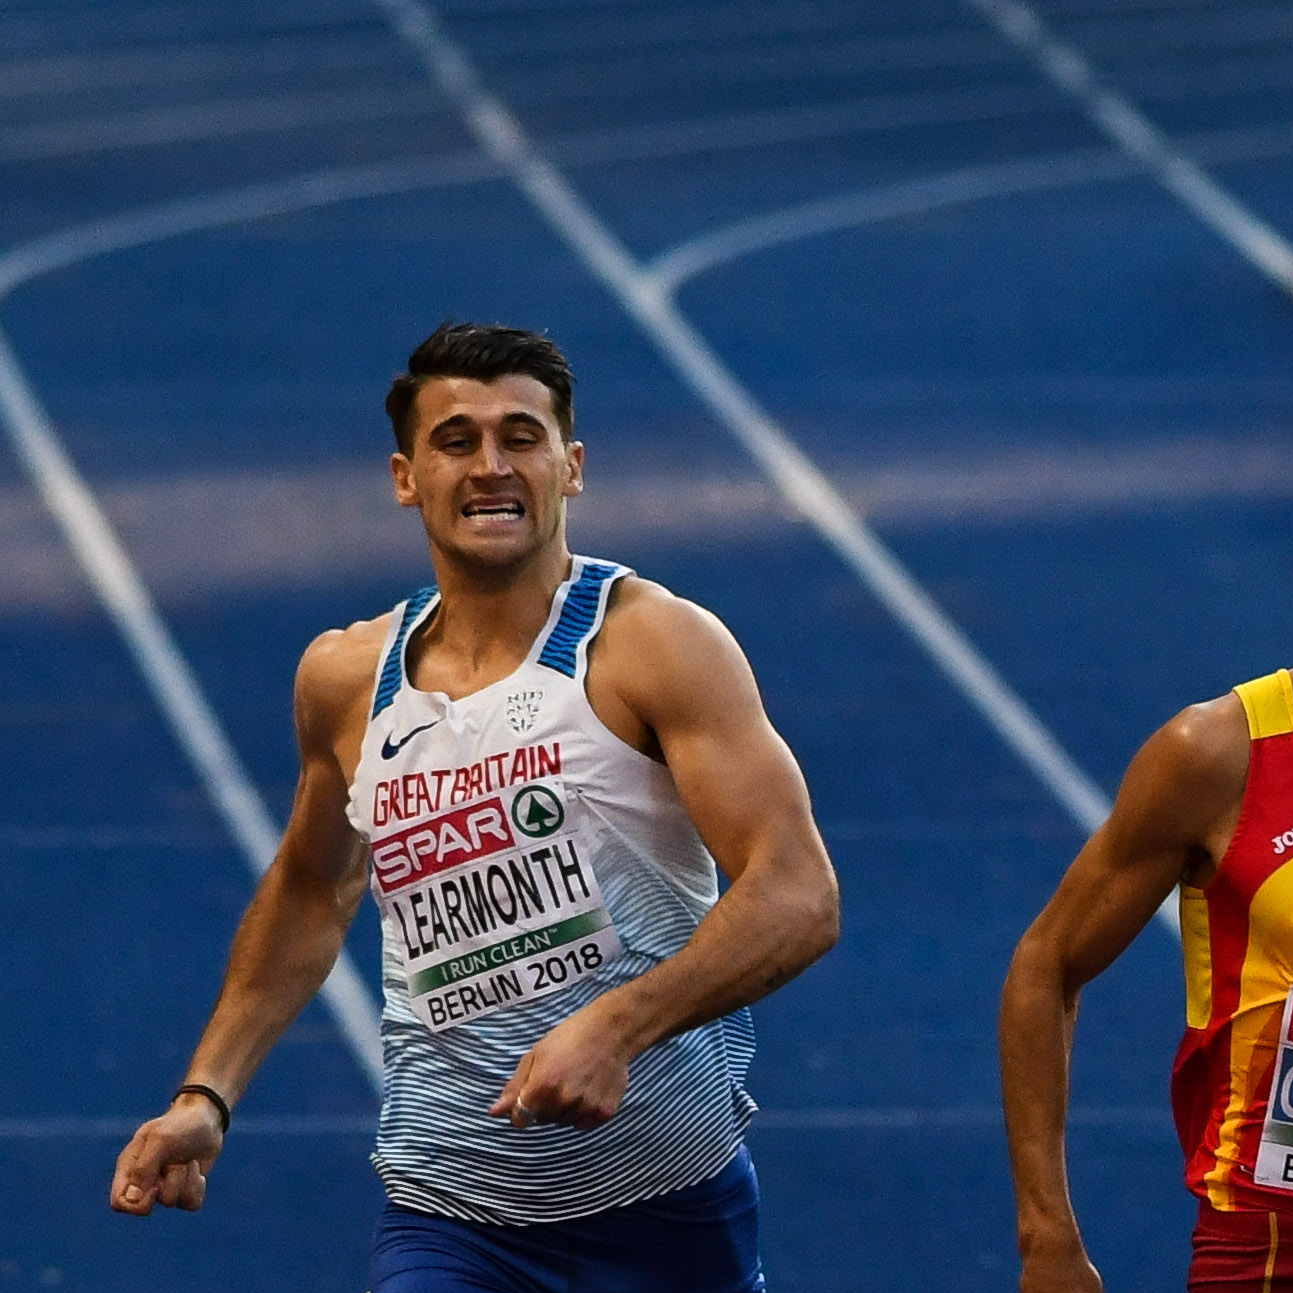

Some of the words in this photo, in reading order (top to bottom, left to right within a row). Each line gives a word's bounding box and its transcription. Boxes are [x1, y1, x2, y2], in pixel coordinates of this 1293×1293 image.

[373, 769, 452, 828] GREAT
[451, 742, 562, 805] BRITAIN
[374, 807, 508, 885] SPAR
[392, 839, 591, 960] LEARMONTH
[427, 968, 523, 1027] BERLIN
[526, 942, 604, 991] 2018
[451, 950, 488, 981] RUN
